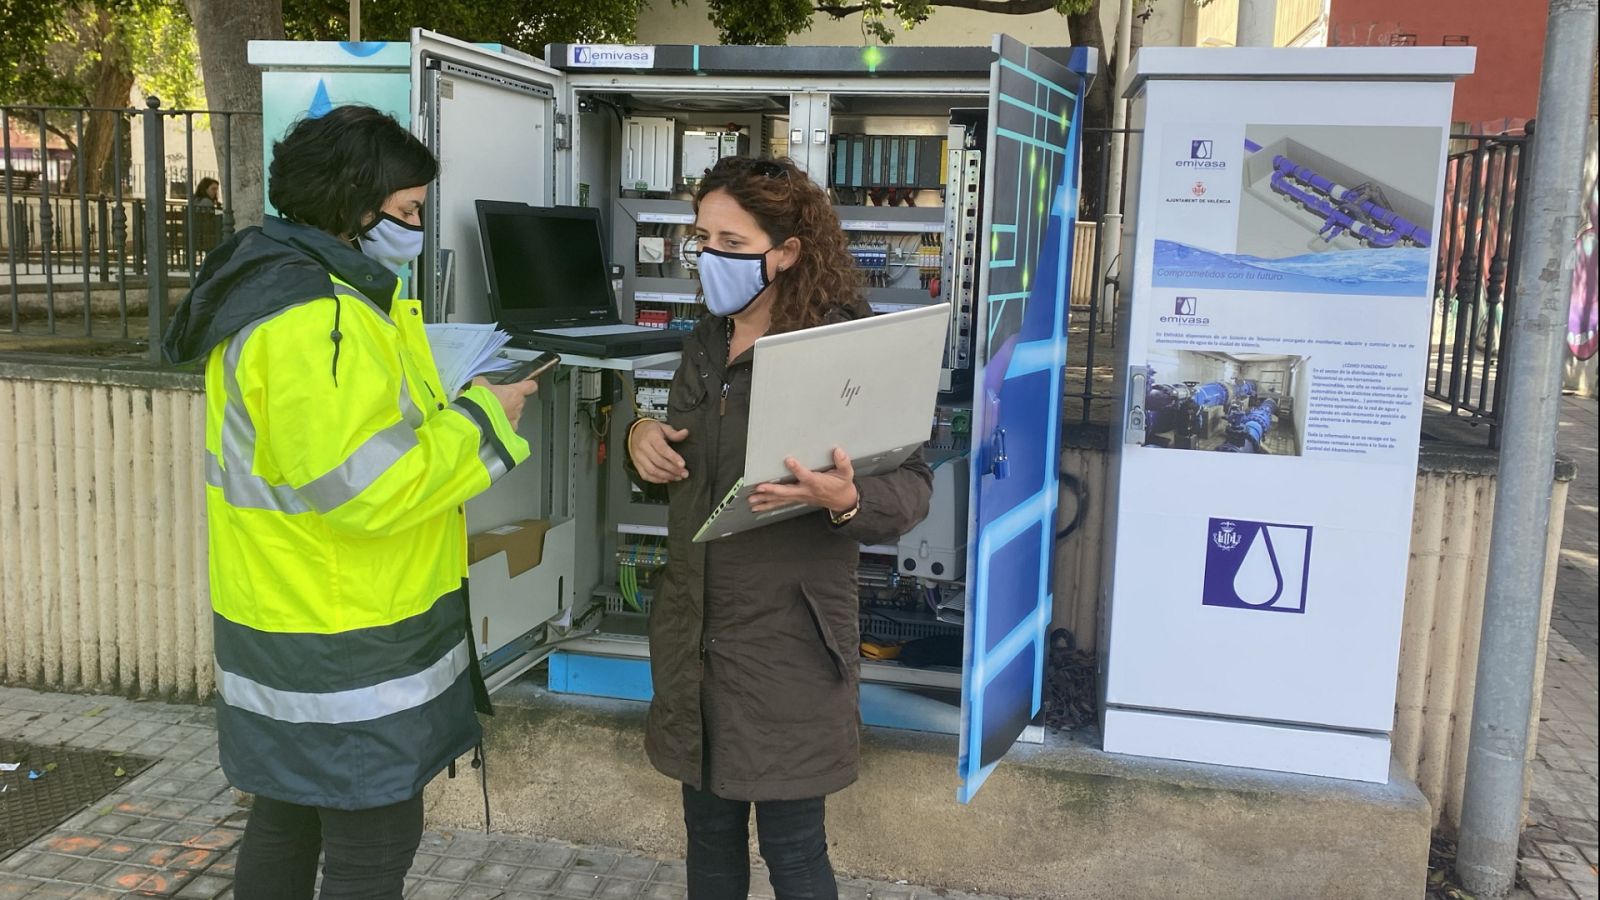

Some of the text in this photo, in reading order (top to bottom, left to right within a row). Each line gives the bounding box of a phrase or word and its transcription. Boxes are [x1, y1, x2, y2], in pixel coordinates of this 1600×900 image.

[592, 49, 648, 60] emivasa
[1157, 268, 1226, 279] Comprometidos
[1160, 315, 1210, 324] emivasa
